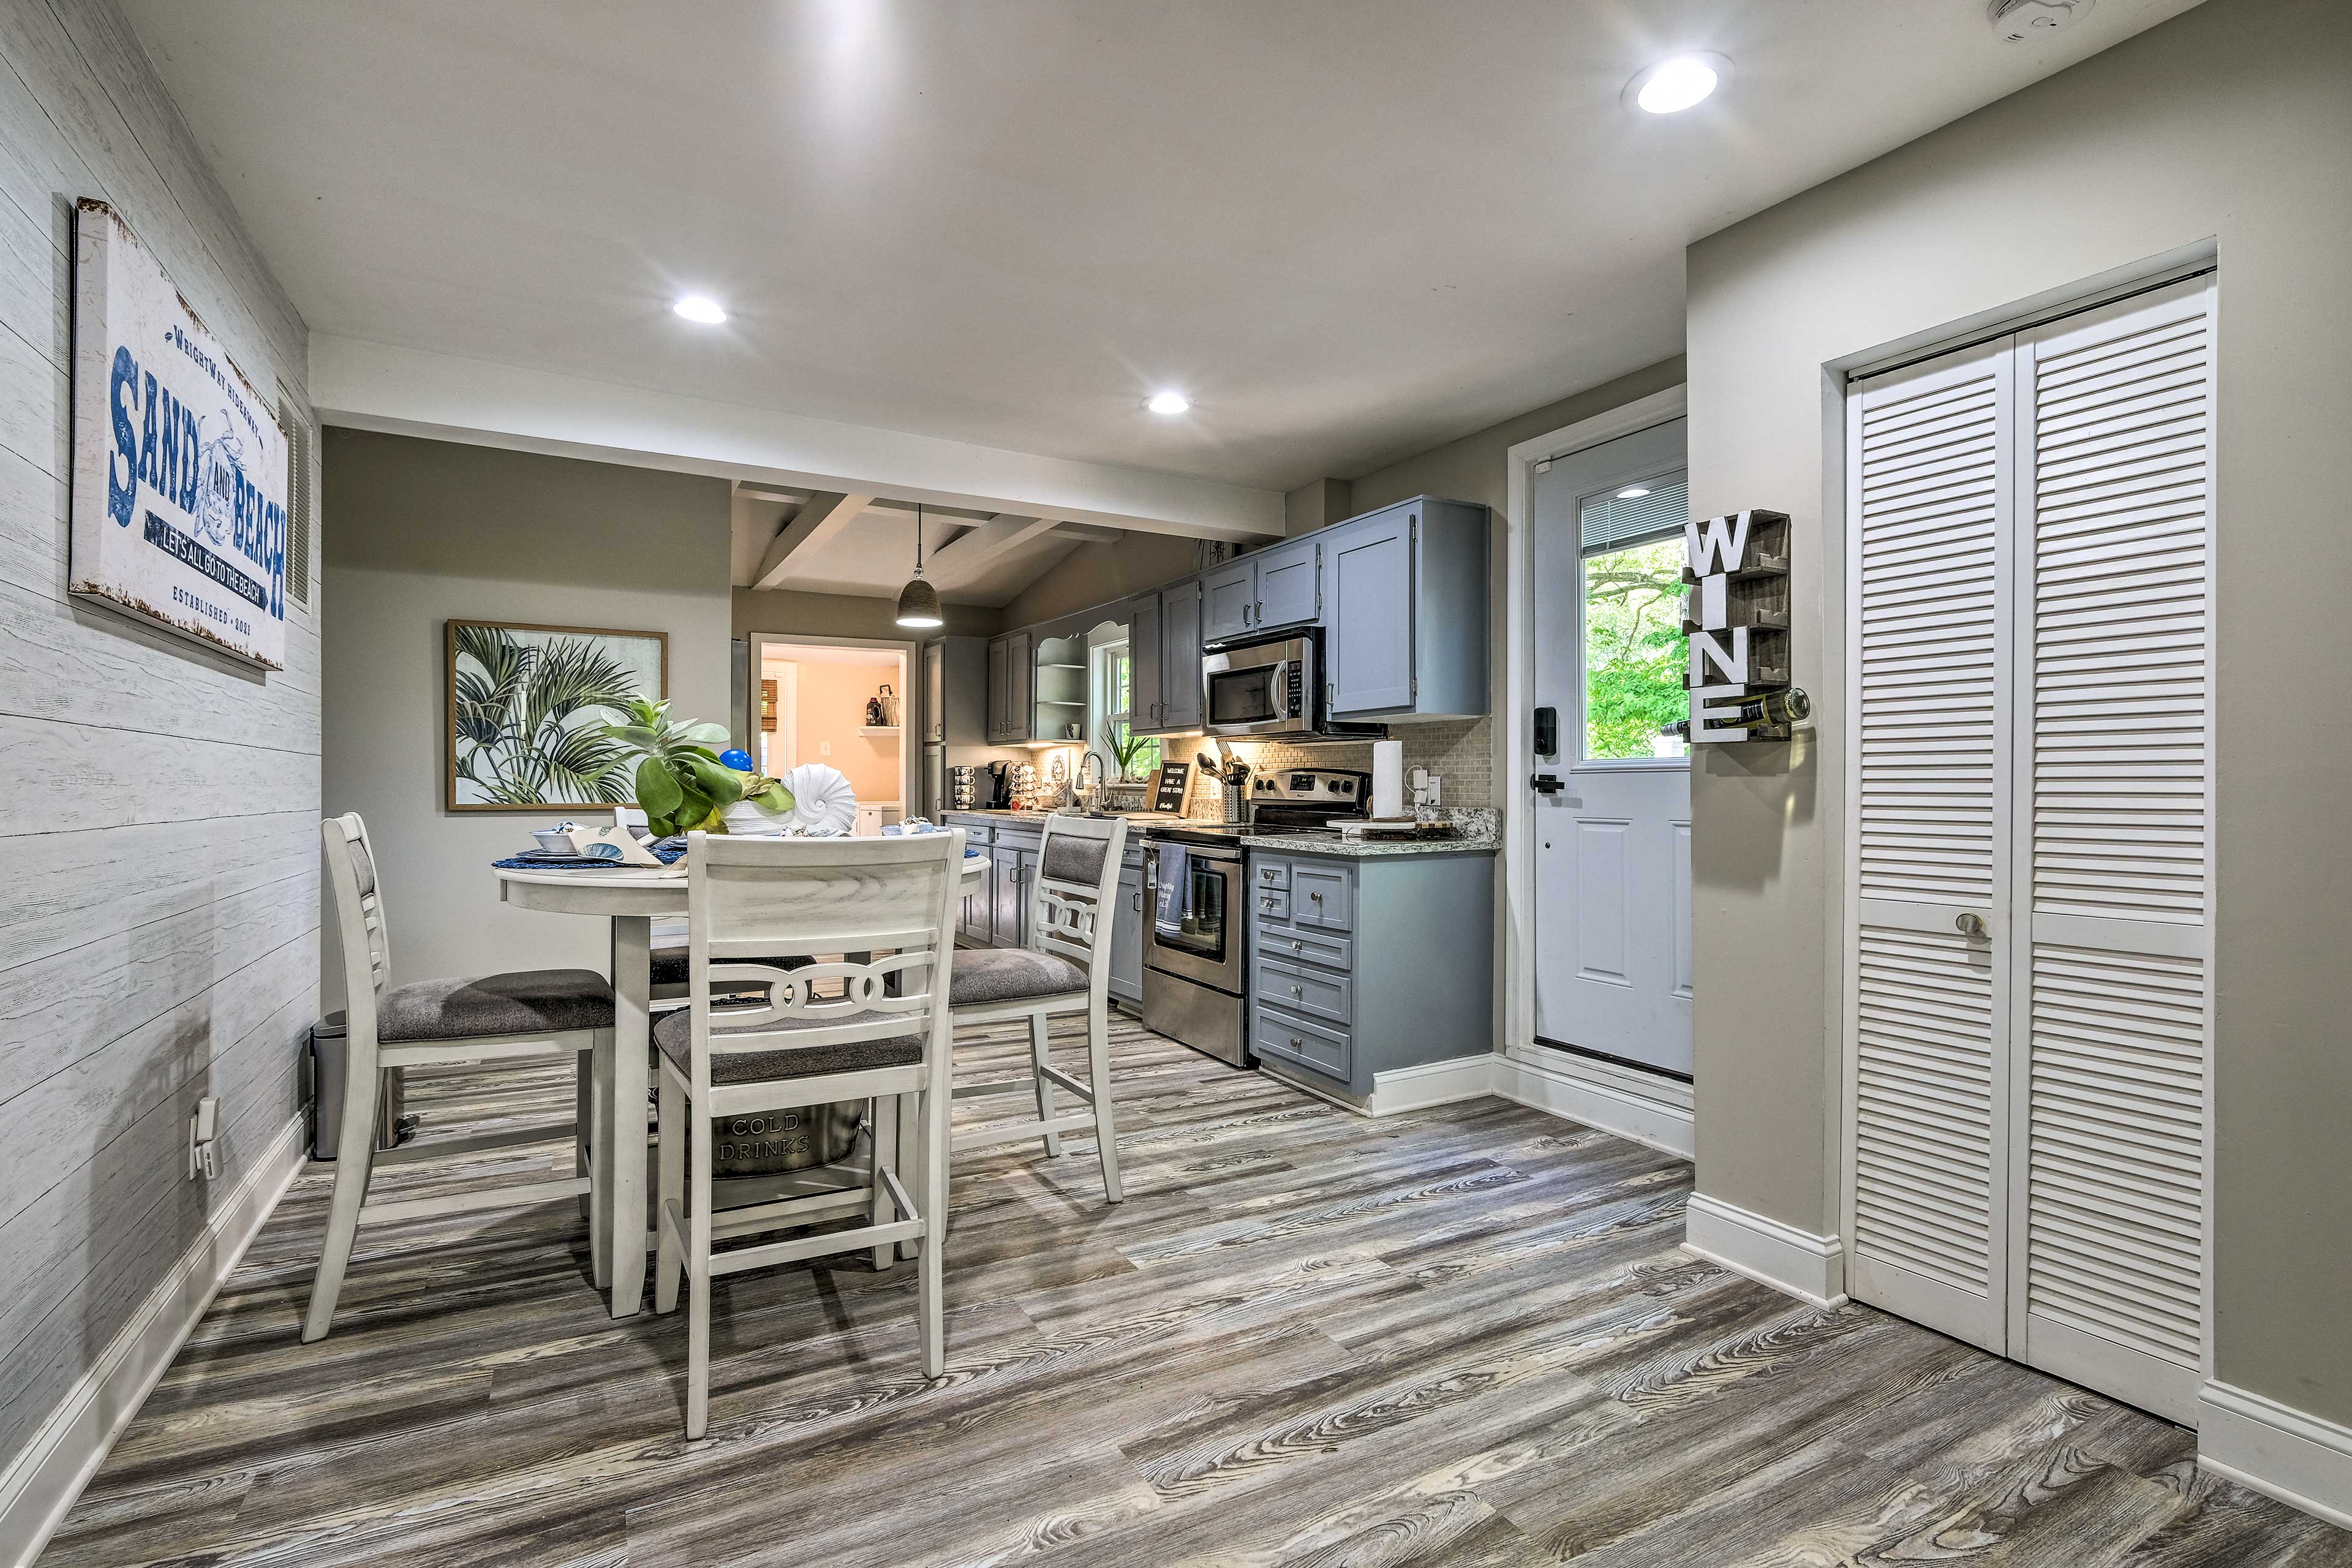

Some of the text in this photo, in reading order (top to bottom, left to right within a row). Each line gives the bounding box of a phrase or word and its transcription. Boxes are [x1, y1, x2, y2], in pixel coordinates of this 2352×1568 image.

[228, 383, 258, 438] HIDEAWAY
[108, 345, 286, 621] SAND AND BEACH
[163, 526, 259, 603] LET'S ALL GO TO THE BEACH
[173, 586, 251, 636] ESTABLISHED 2021
[1684, 509, 1753, 743] WINE
[720, 1135, 809, 1160] DRINKS
[733, 1115, 799, 1135] COLD
